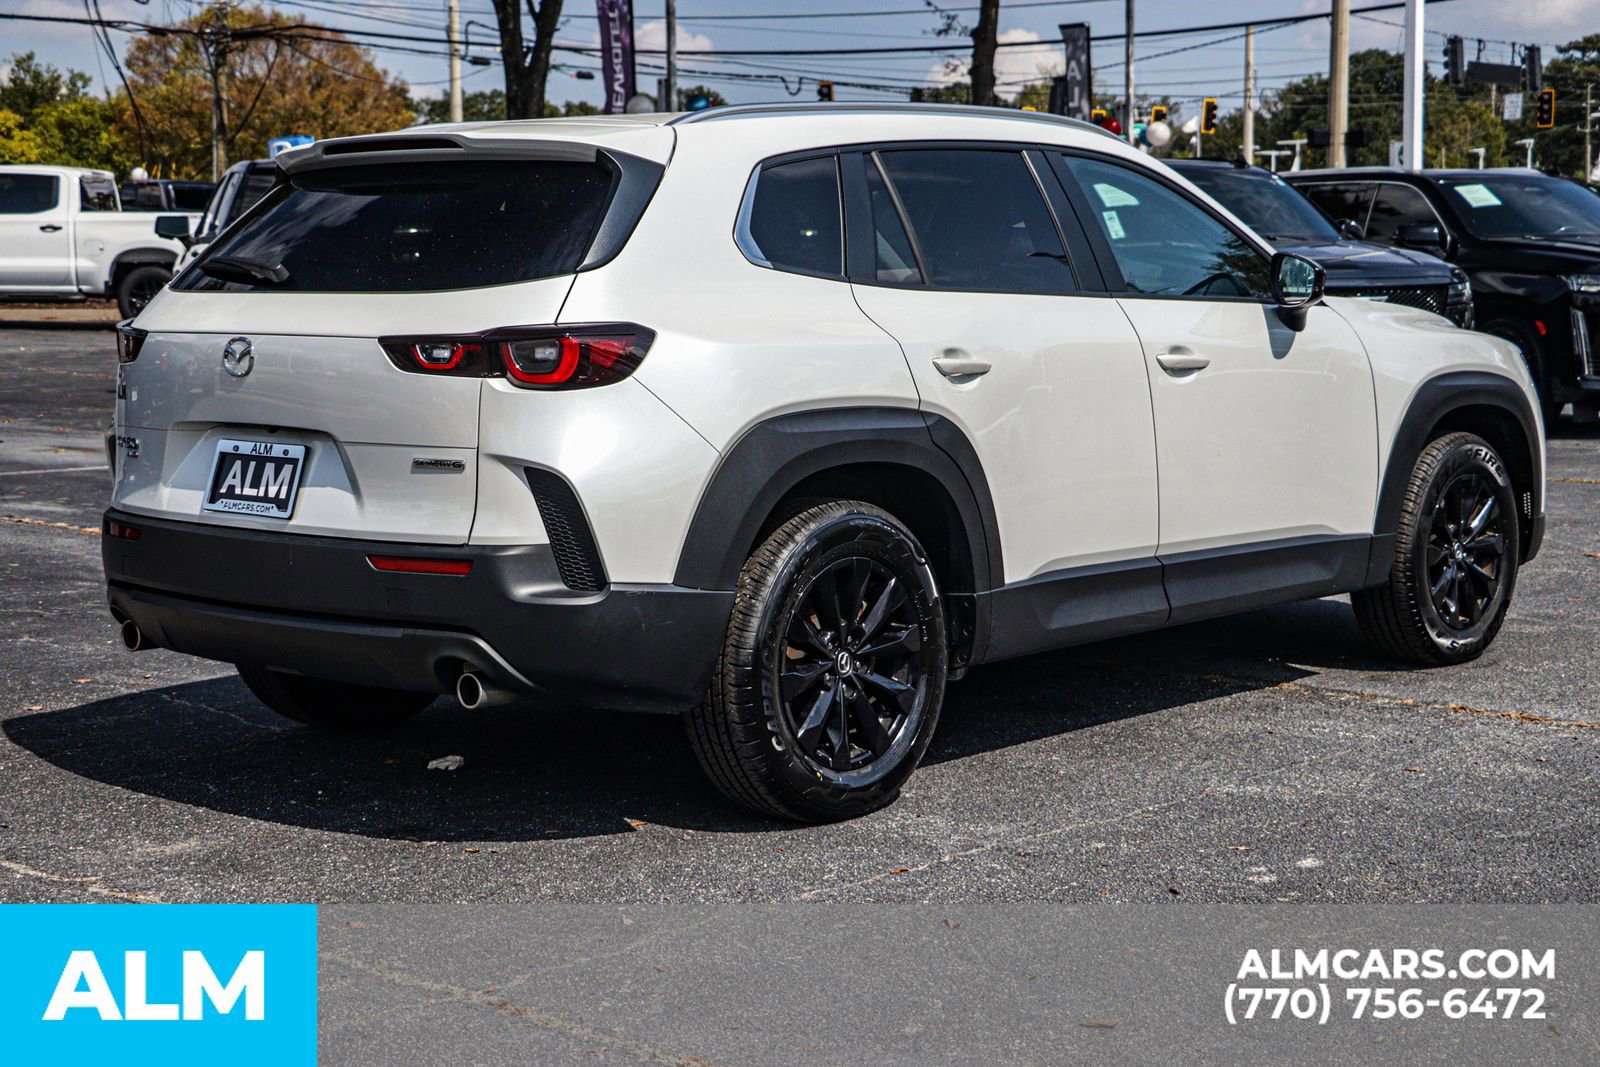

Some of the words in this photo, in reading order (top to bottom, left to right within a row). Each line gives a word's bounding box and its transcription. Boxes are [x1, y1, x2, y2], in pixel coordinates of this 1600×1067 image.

[250, 443, 273, 455] ALM
[219, 460, 294, 499] ALM
[222, 501, 272, 513] ALMCARS.COM
